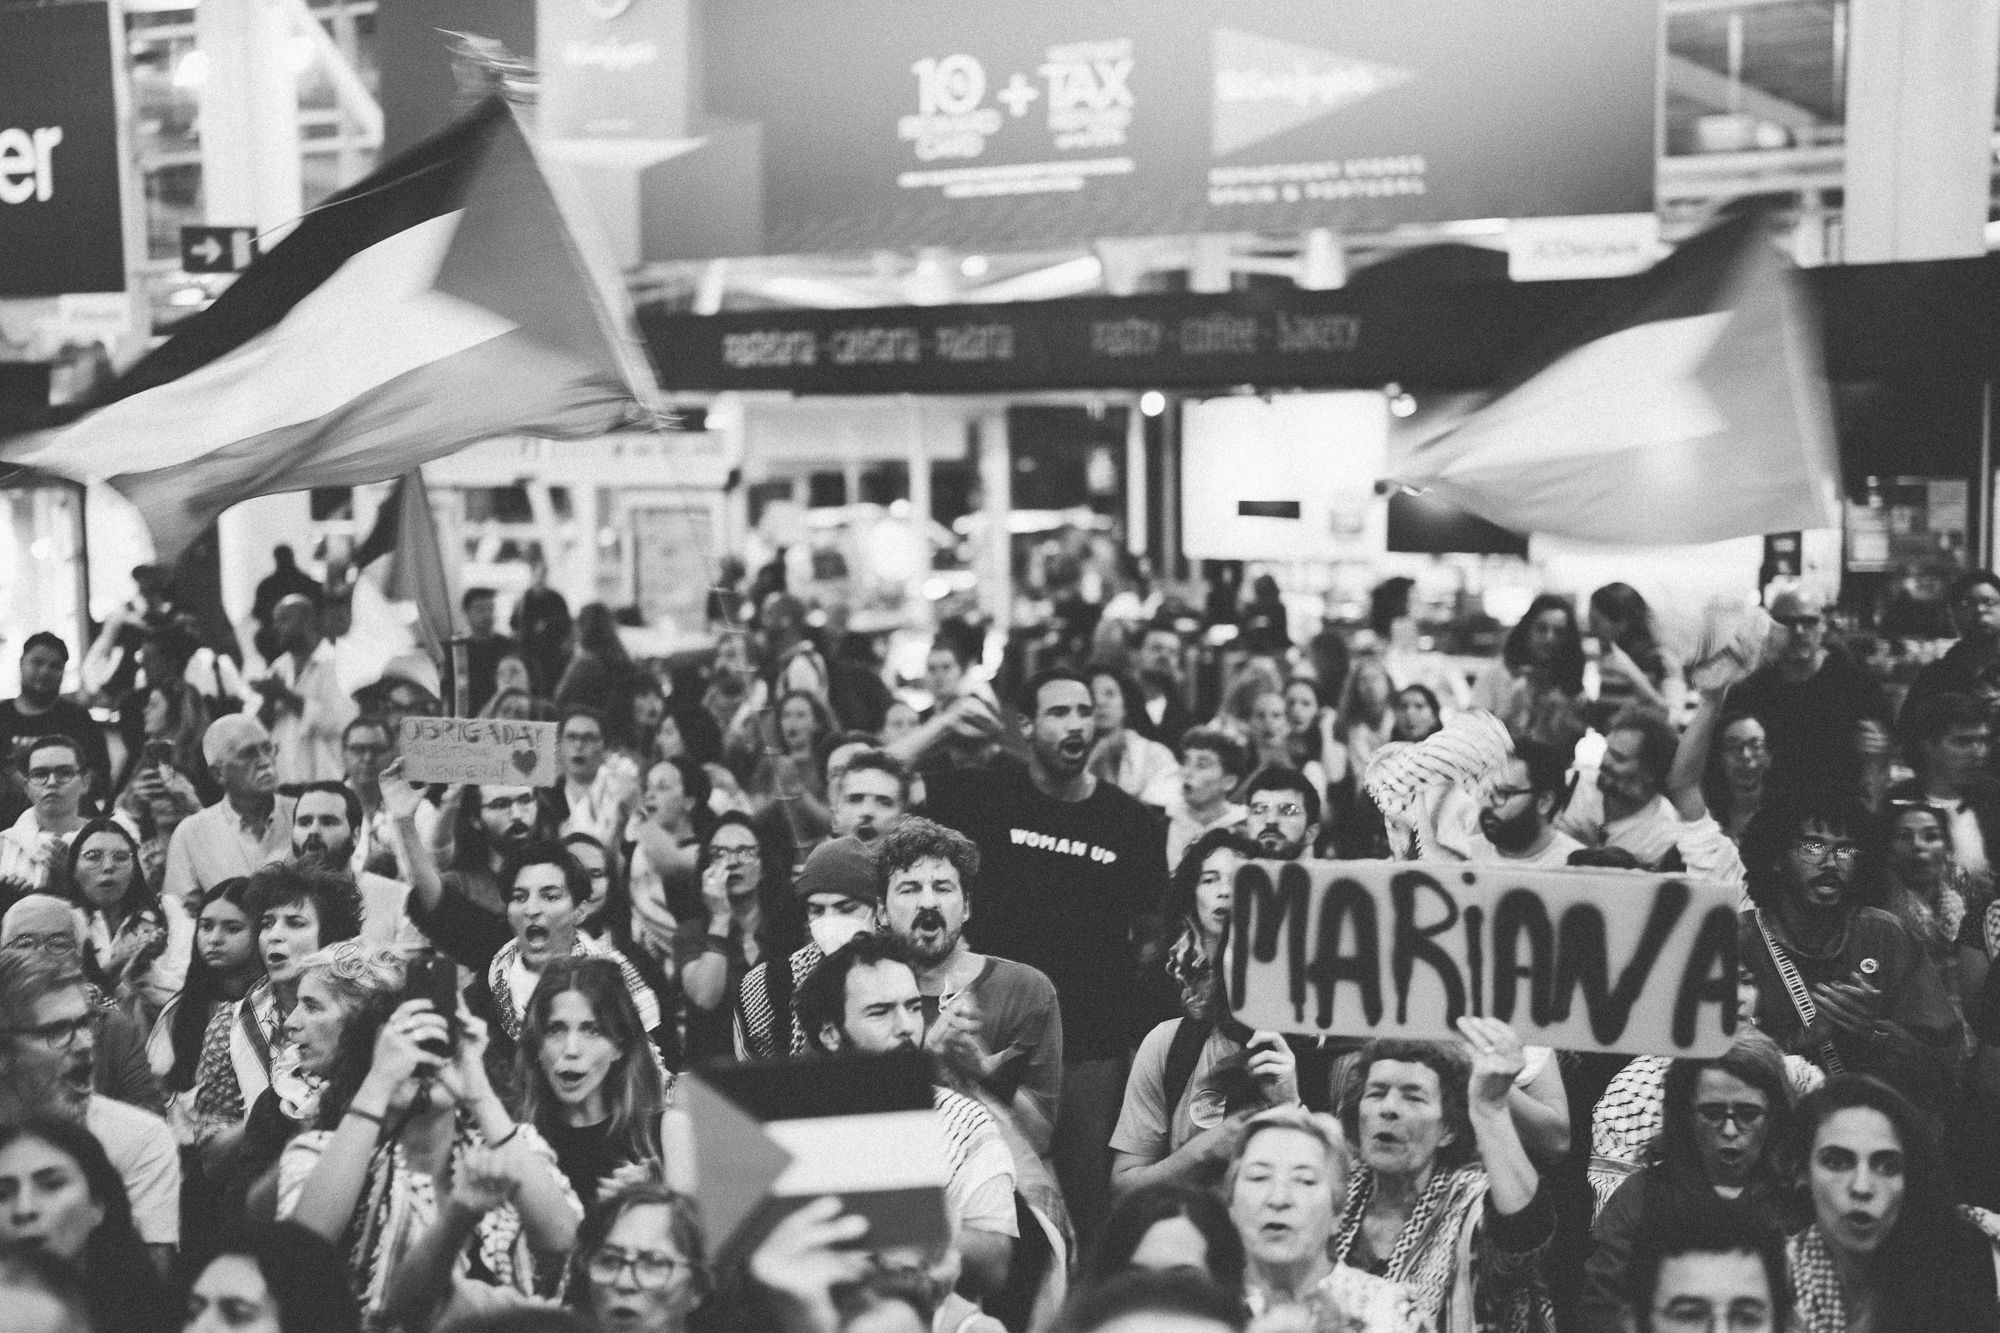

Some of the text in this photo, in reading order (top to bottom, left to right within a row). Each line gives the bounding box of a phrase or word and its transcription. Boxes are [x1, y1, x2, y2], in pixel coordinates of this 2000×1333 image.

[911, 53, 986, 115] 10
[1037, 58, 1136, 109] TAX
[1010, 828, 1117, 865] WOMAN UP
